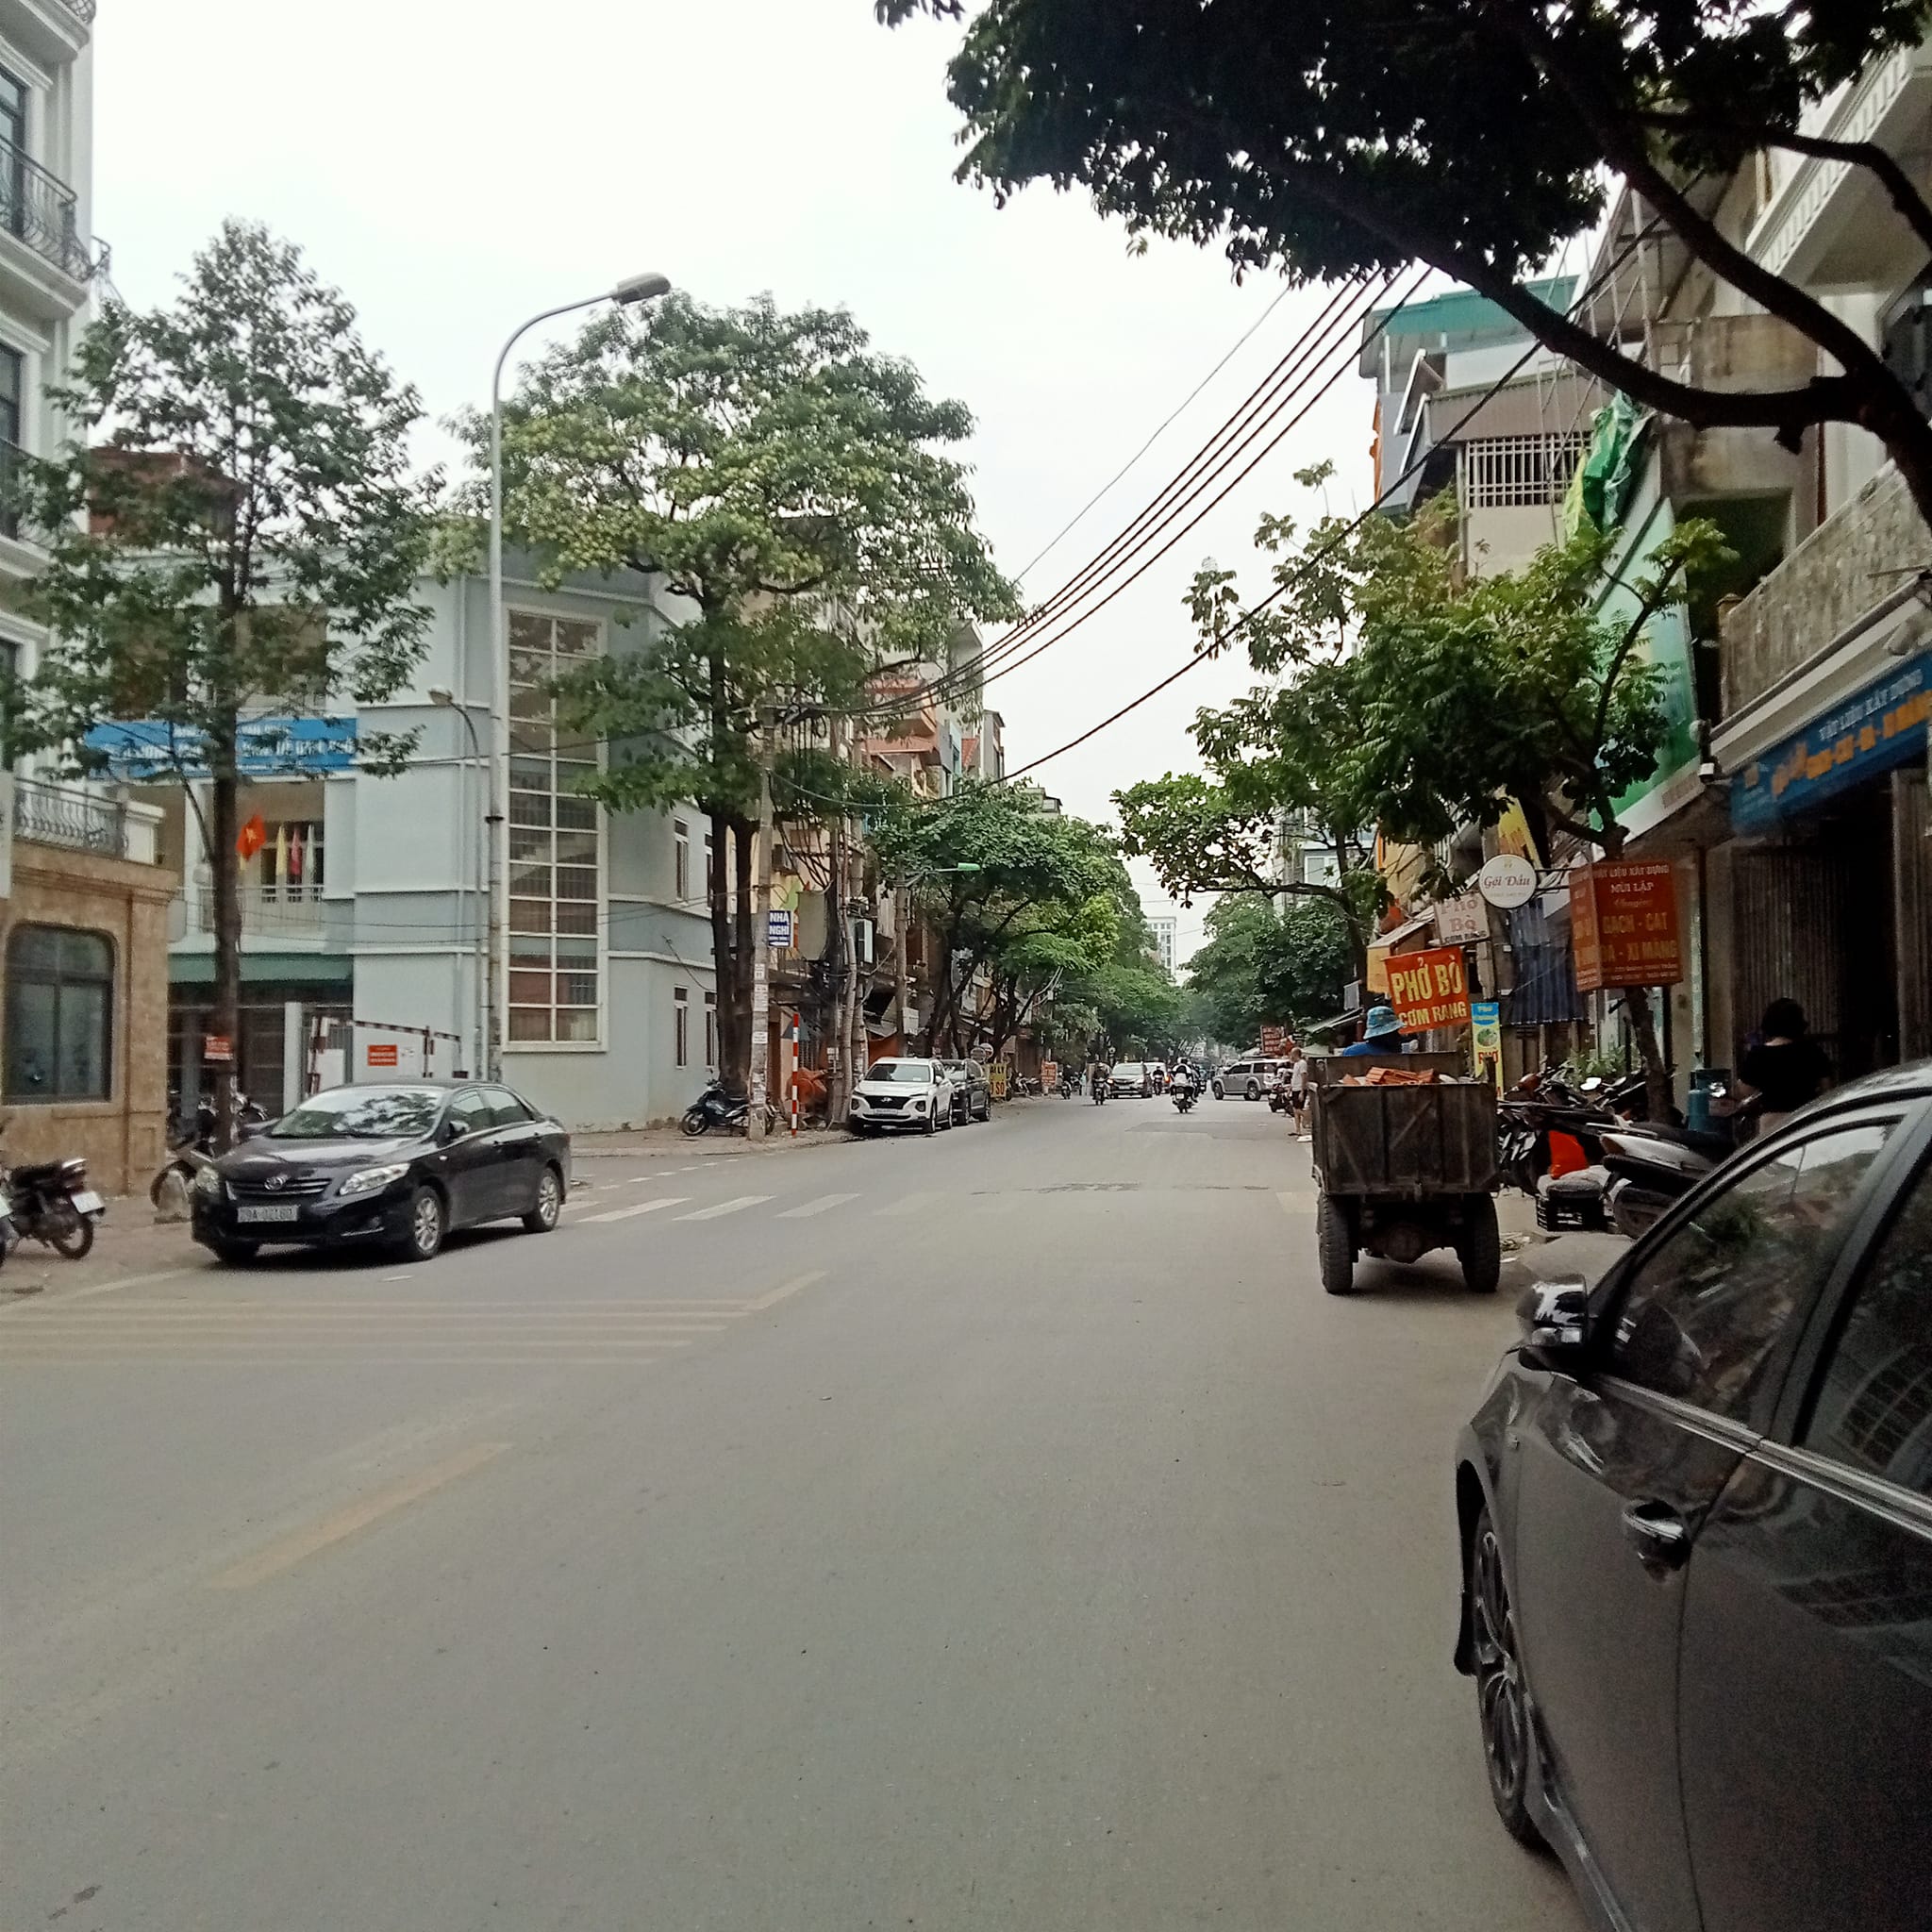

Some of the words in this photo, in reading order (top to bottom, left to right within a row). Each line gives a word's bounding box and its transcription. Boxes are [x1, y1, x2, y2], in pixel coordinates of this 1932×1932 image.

[1391, 957, 1433, 1005] PHỞ
[1434, 954, 1463, 997] BÒ
[1398, 1008, 1430, 1028] CƠM
[1431, 1001, 1468, 1023] RANG
